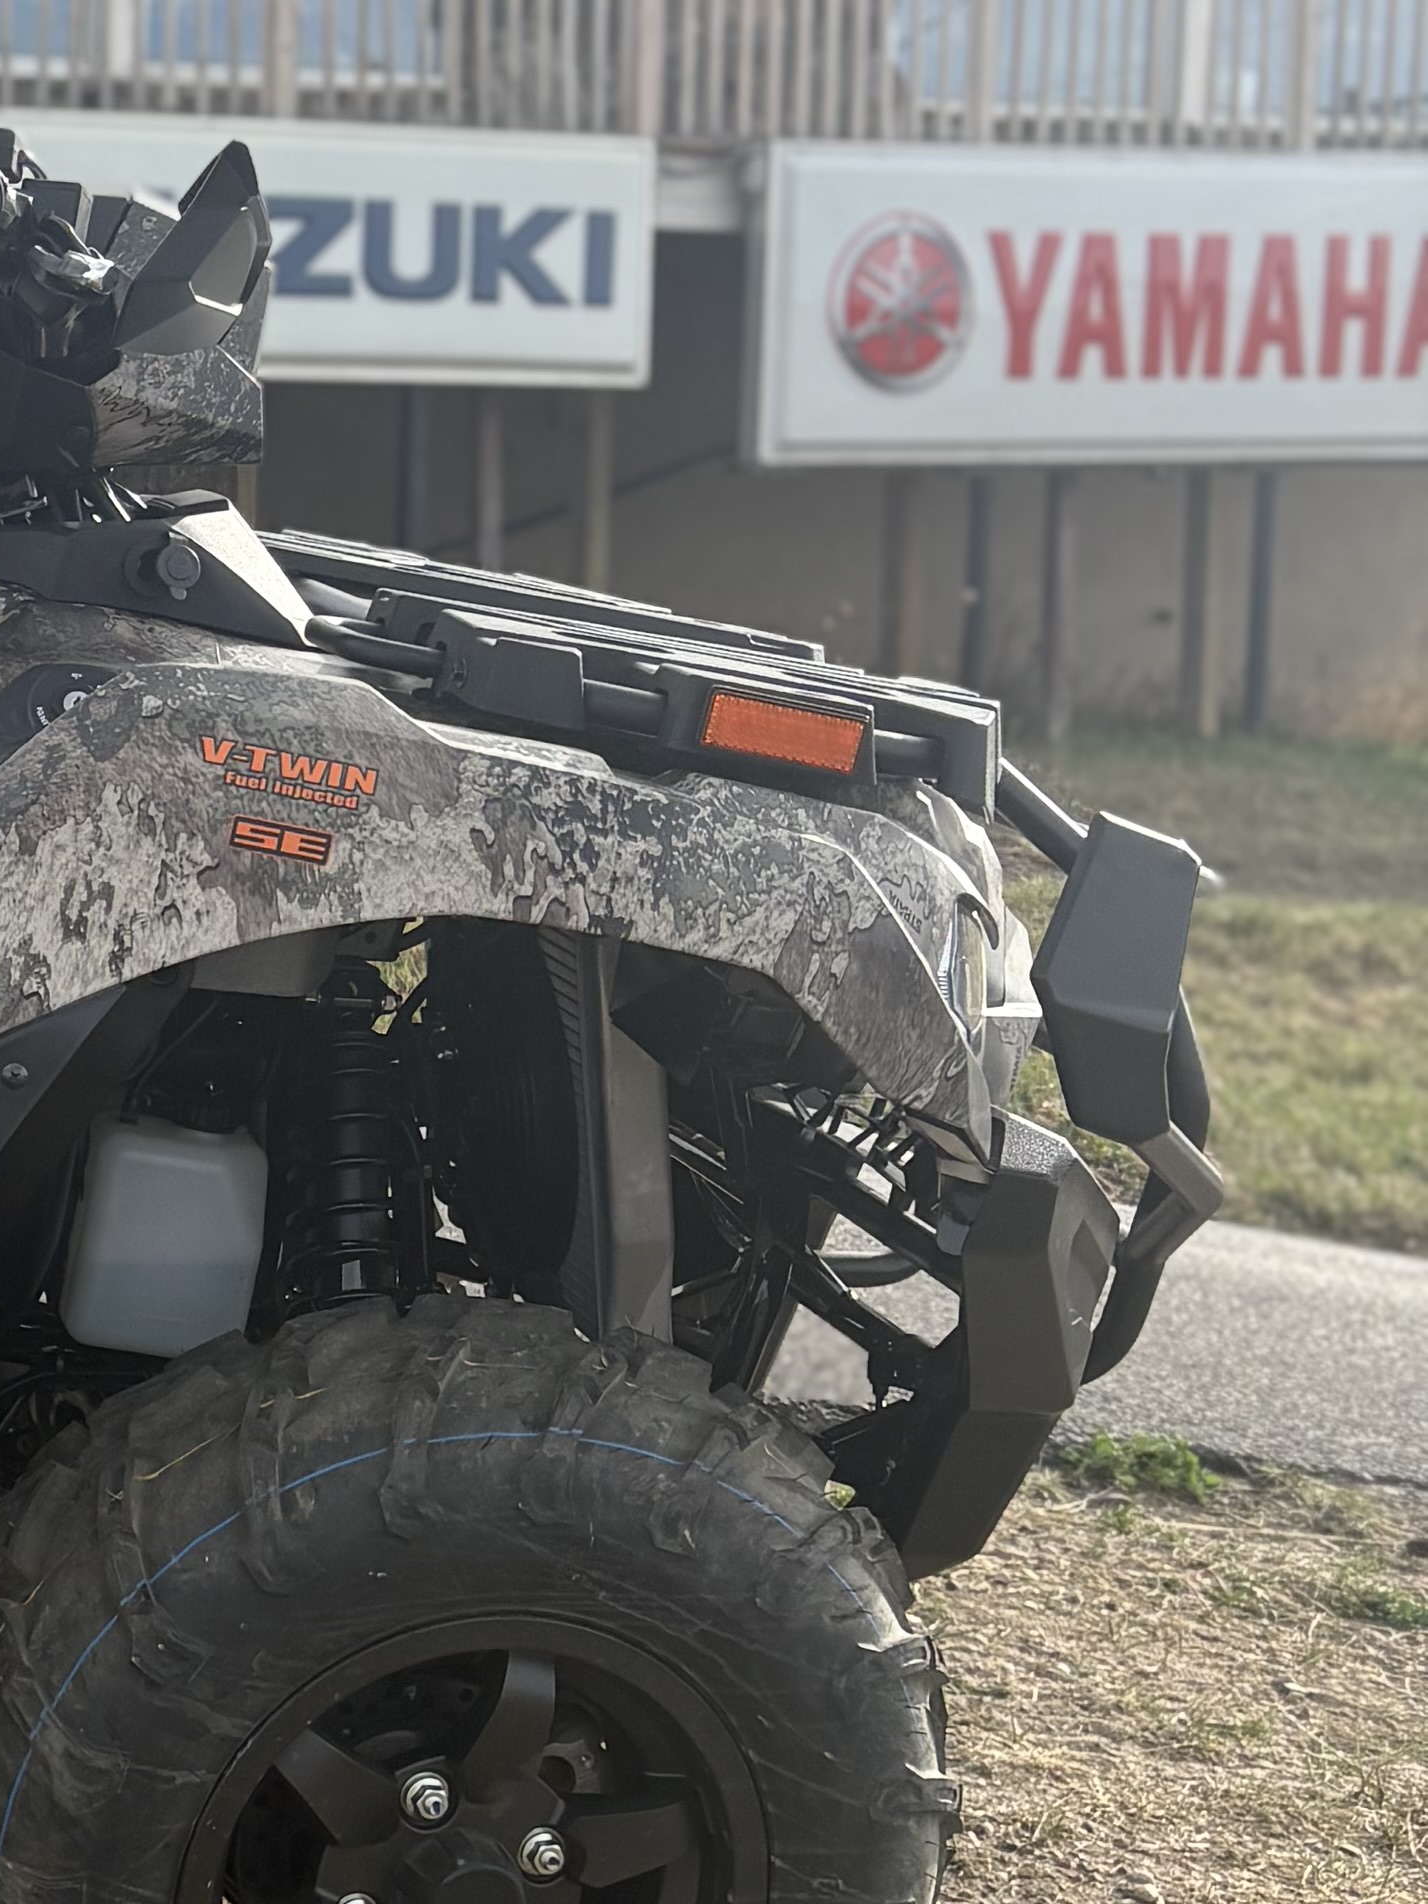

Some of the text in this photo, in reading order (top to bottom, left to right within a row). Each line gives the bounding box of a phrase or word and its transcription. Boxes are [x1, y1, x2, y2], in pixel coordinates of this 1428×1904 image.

[270, 194, 619, 307] ZUKI
[199, 734, 379, 796] V-TWIN
[224, 770, 268, 791] Fuel
[232, 820, 329, 861] SE
